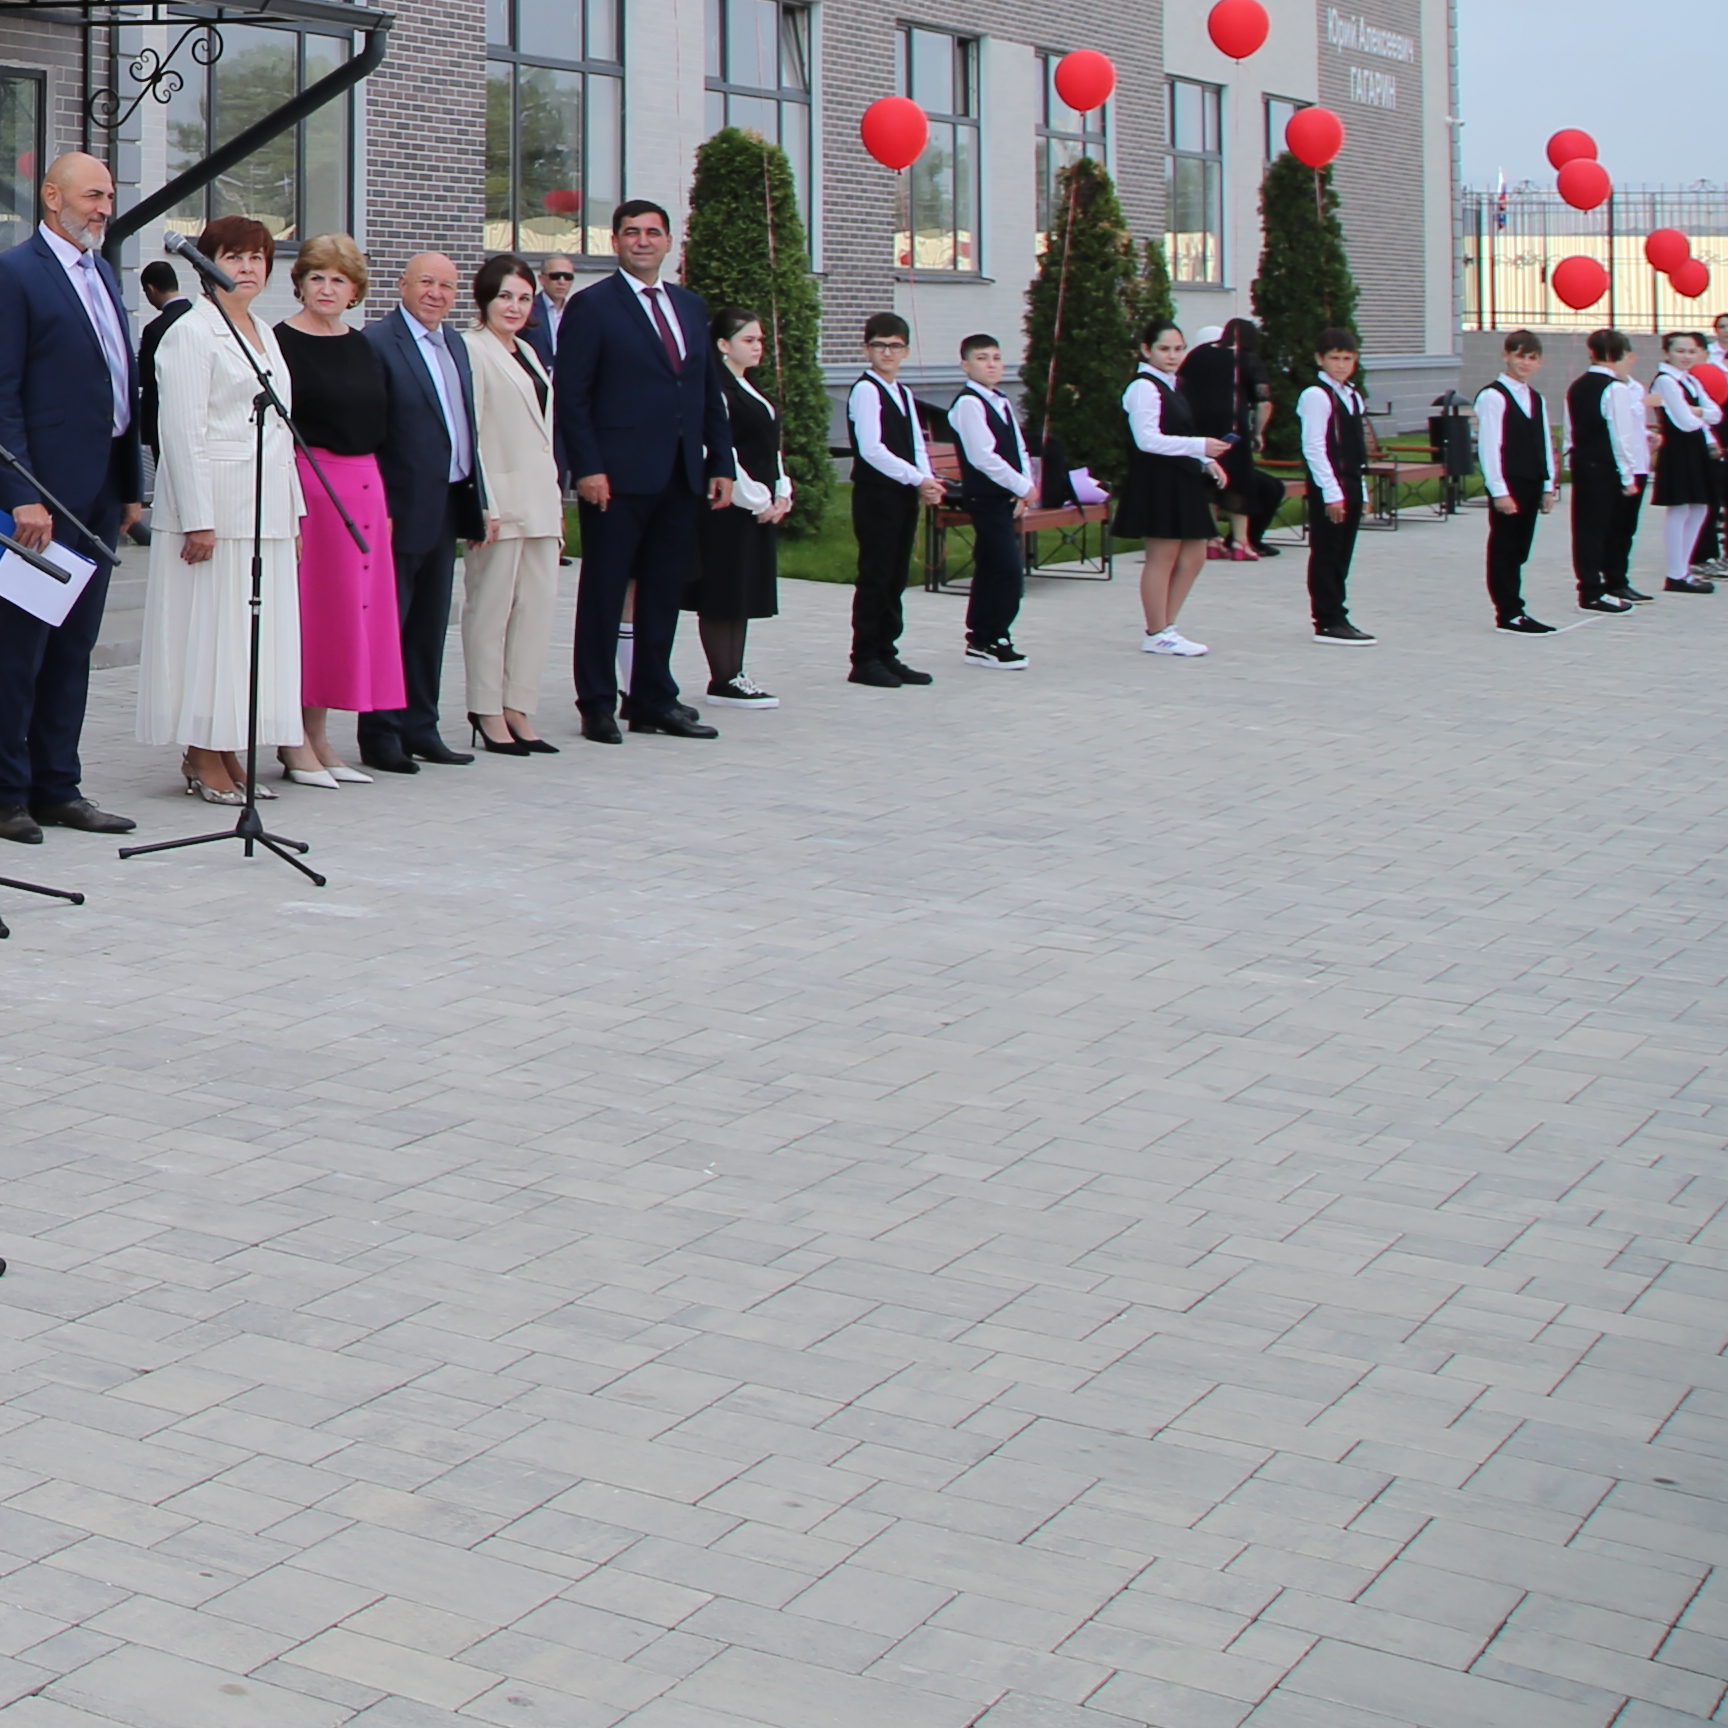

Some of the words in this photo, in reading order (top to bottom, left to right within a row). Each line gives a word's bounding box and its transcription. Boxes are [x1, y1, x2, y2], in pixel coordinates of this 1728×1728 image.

[1328, 7, 1357, 53] Юрий
[1359, 16, 1414, 64] Алексеевич
[1350, 66, 1396, 110] ГАГАРИН
